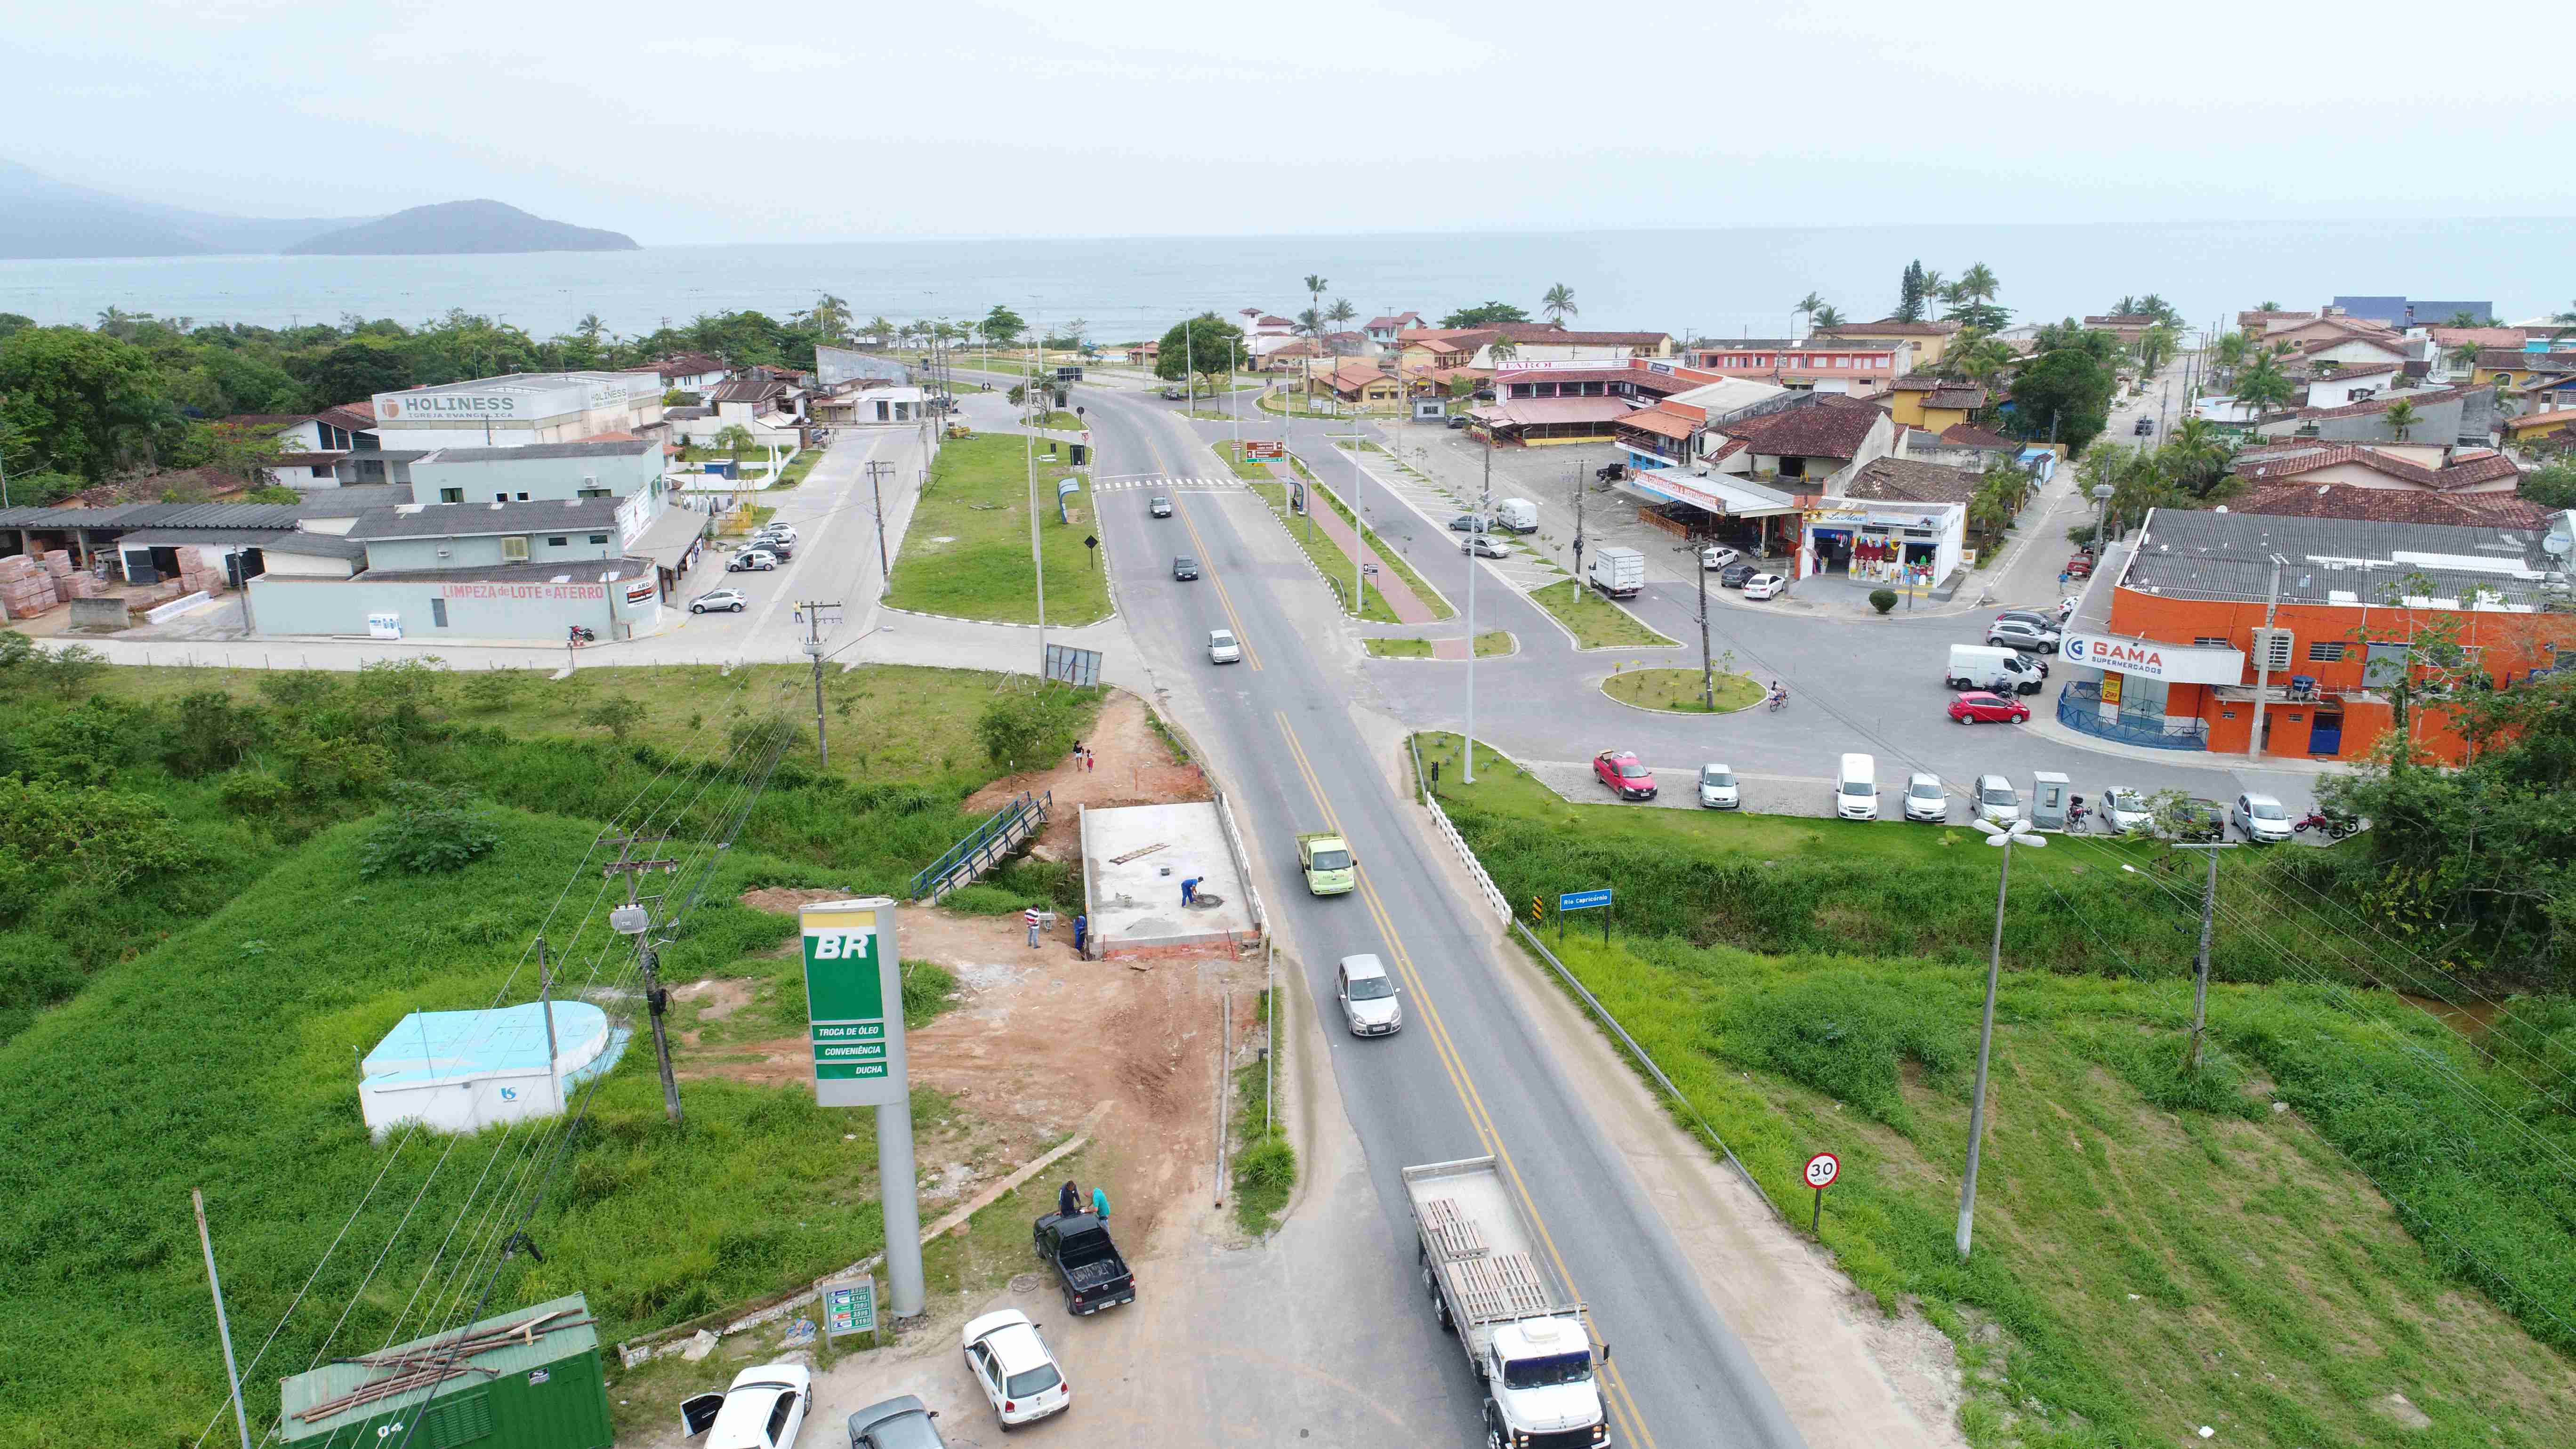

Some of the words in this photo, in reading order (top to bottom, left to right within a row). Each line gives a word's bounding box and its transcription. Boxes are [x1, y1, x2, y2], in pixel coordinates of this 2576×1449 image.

[591, 389, 626, 402] HOLINESS
[405, 397, 514, 411] HOLINESS
[1637, 472, 1648, 480] GAMA
[443, 586, 497, 598] LIMPEZA
[499, 587, 510, 596] de
[511, 586, 542, 599] LOTE
[546, 588, 552, 596] e
[553, 586, 604, 599] ATERRO
[2093, 641, 2162, 667] GAMA
[2092, 656, 2162, 675] SUPERMERCADOS
[1575, 894, 1608, 904] Capricórnio
[814, 934, 869, 959] BR
[819, 1028, 844, 1036] TROCA
[858, 1026, 879, 1034] ÓLEO
[825, 1045, 881, 1056] CONVENIÊNCIA
[855, 1065, 883, 1074] DUCHA
[1811, 1162, 1833, 1177] 30
[378, 1422, 403, 1437] 04
